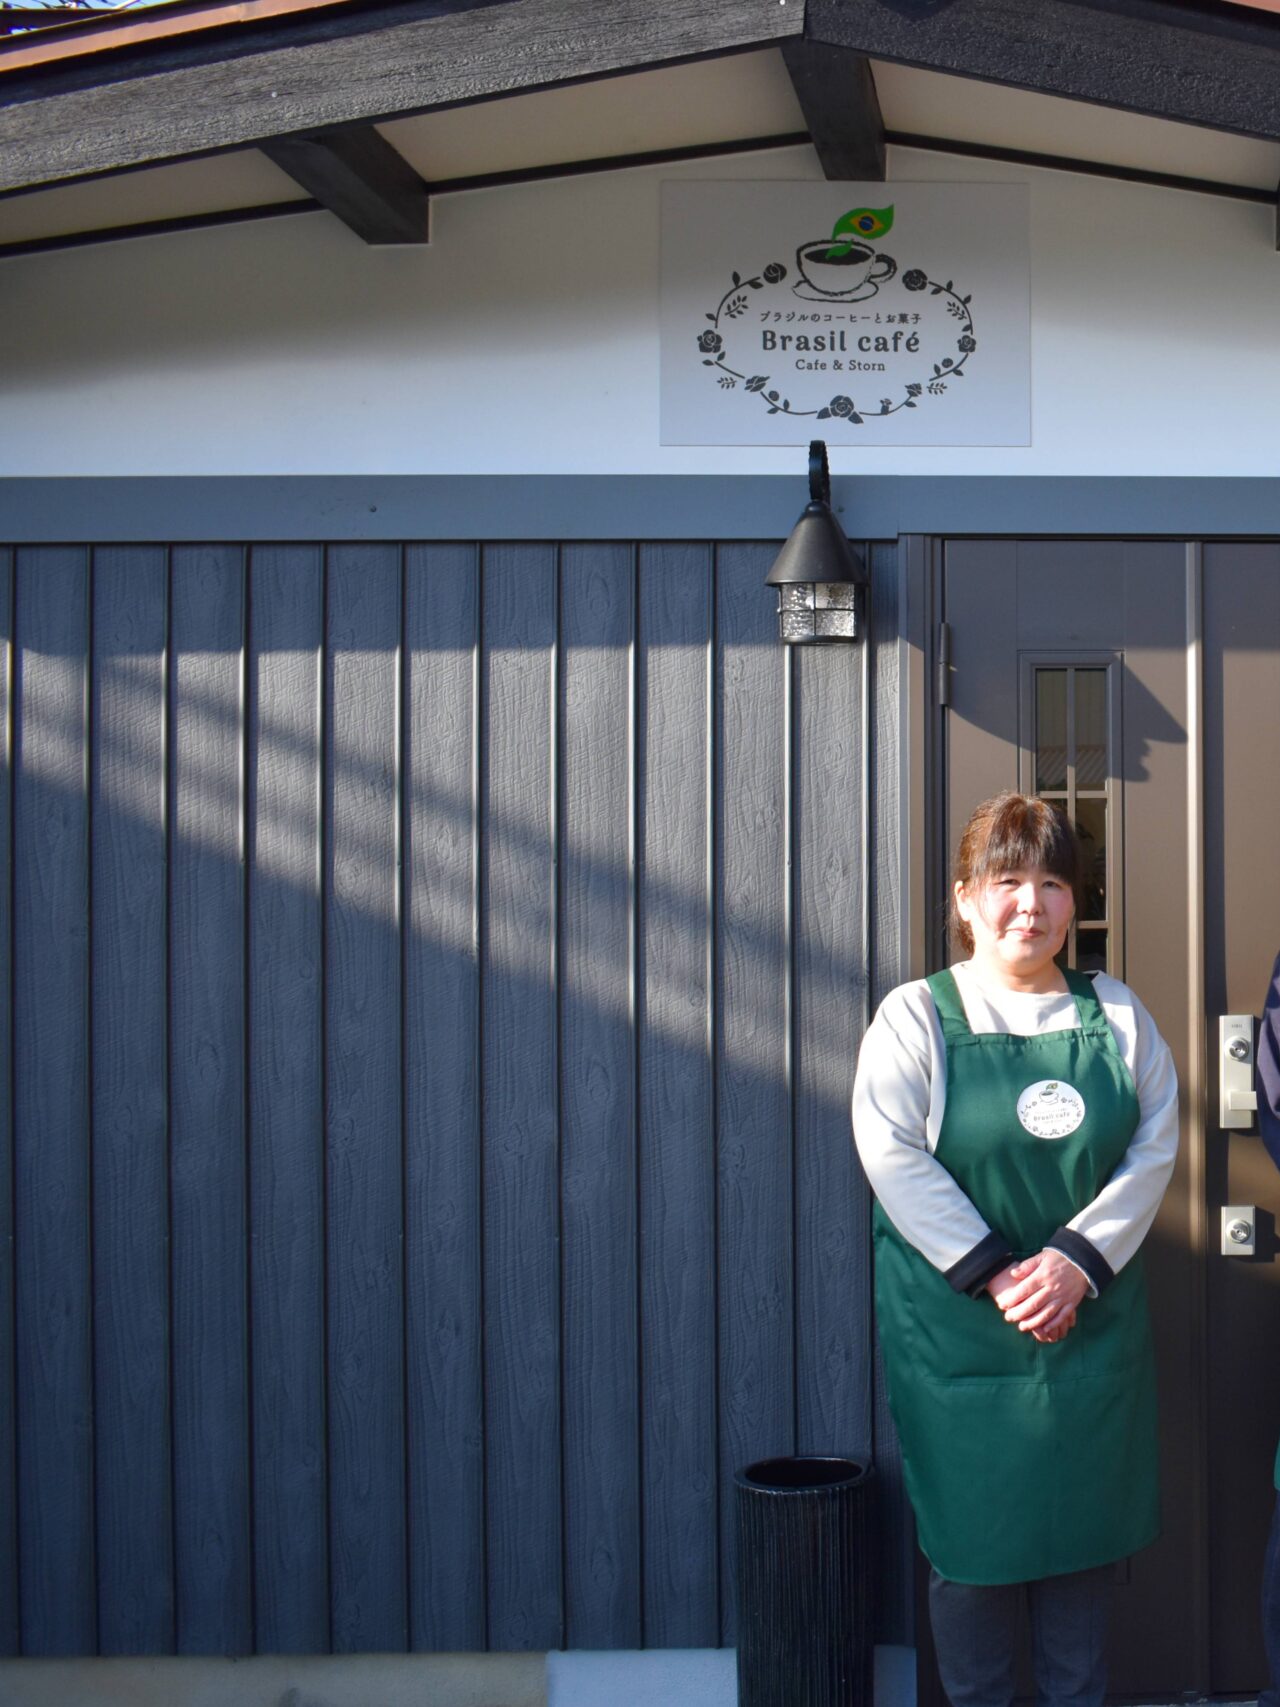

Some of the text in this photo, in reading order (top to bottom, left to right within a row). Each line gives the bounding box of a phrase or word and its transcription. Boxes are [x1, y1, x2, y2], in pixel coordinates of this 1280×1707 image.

[760, 310, 922, 325] ブラジルのコーヒーとお菓子
[762, 330, 921, 353] Brasil café
[795, 359, 886, 371] Cafe & Storn
